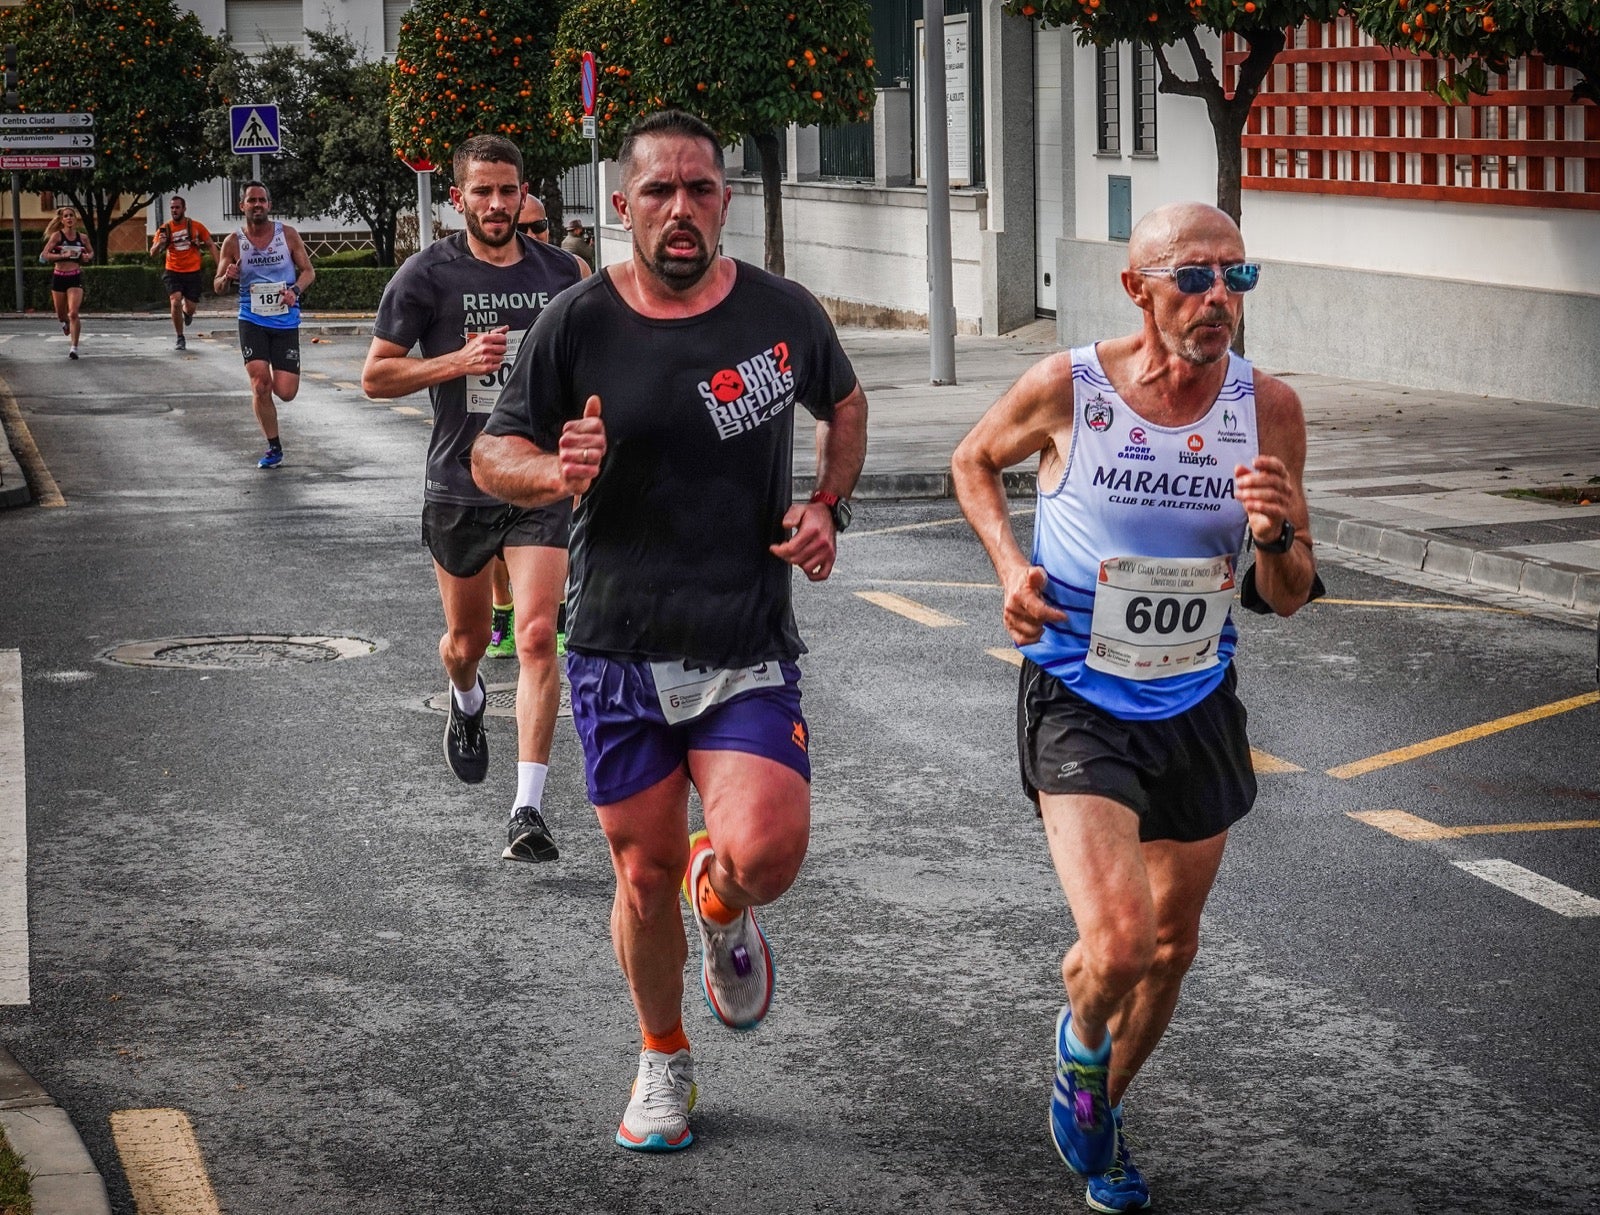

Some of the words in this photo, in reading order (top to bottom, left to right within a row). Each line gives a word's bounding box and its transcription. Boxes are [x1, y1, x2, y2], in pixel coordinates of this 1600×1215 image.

[2, 117, 28, 125] Centro
[28, 116, 56, 125] Ciudad
[259, 293, 281, 305] 187
[463, 292, 549, 311] REMOVE
[464, 311, 498, 326] AND
[709, 370, 795, 427] RUEDAS
[717, 391, 795, 440] Bikes
[1117, 451, 1156, 462] GARRIDO
[1124, 445, 1151, 454] SPORT
[1178, 453, 1218, 468] mayfo
[1092, 465, 1236, 500] MARACENA
[1108, 495, 1138, 506] CLUB
[1140, 498, 1155, 507] DE
[1157, 499, 1221, 512] ATLETISMO
[1125, 595, 1207, 635] 600
